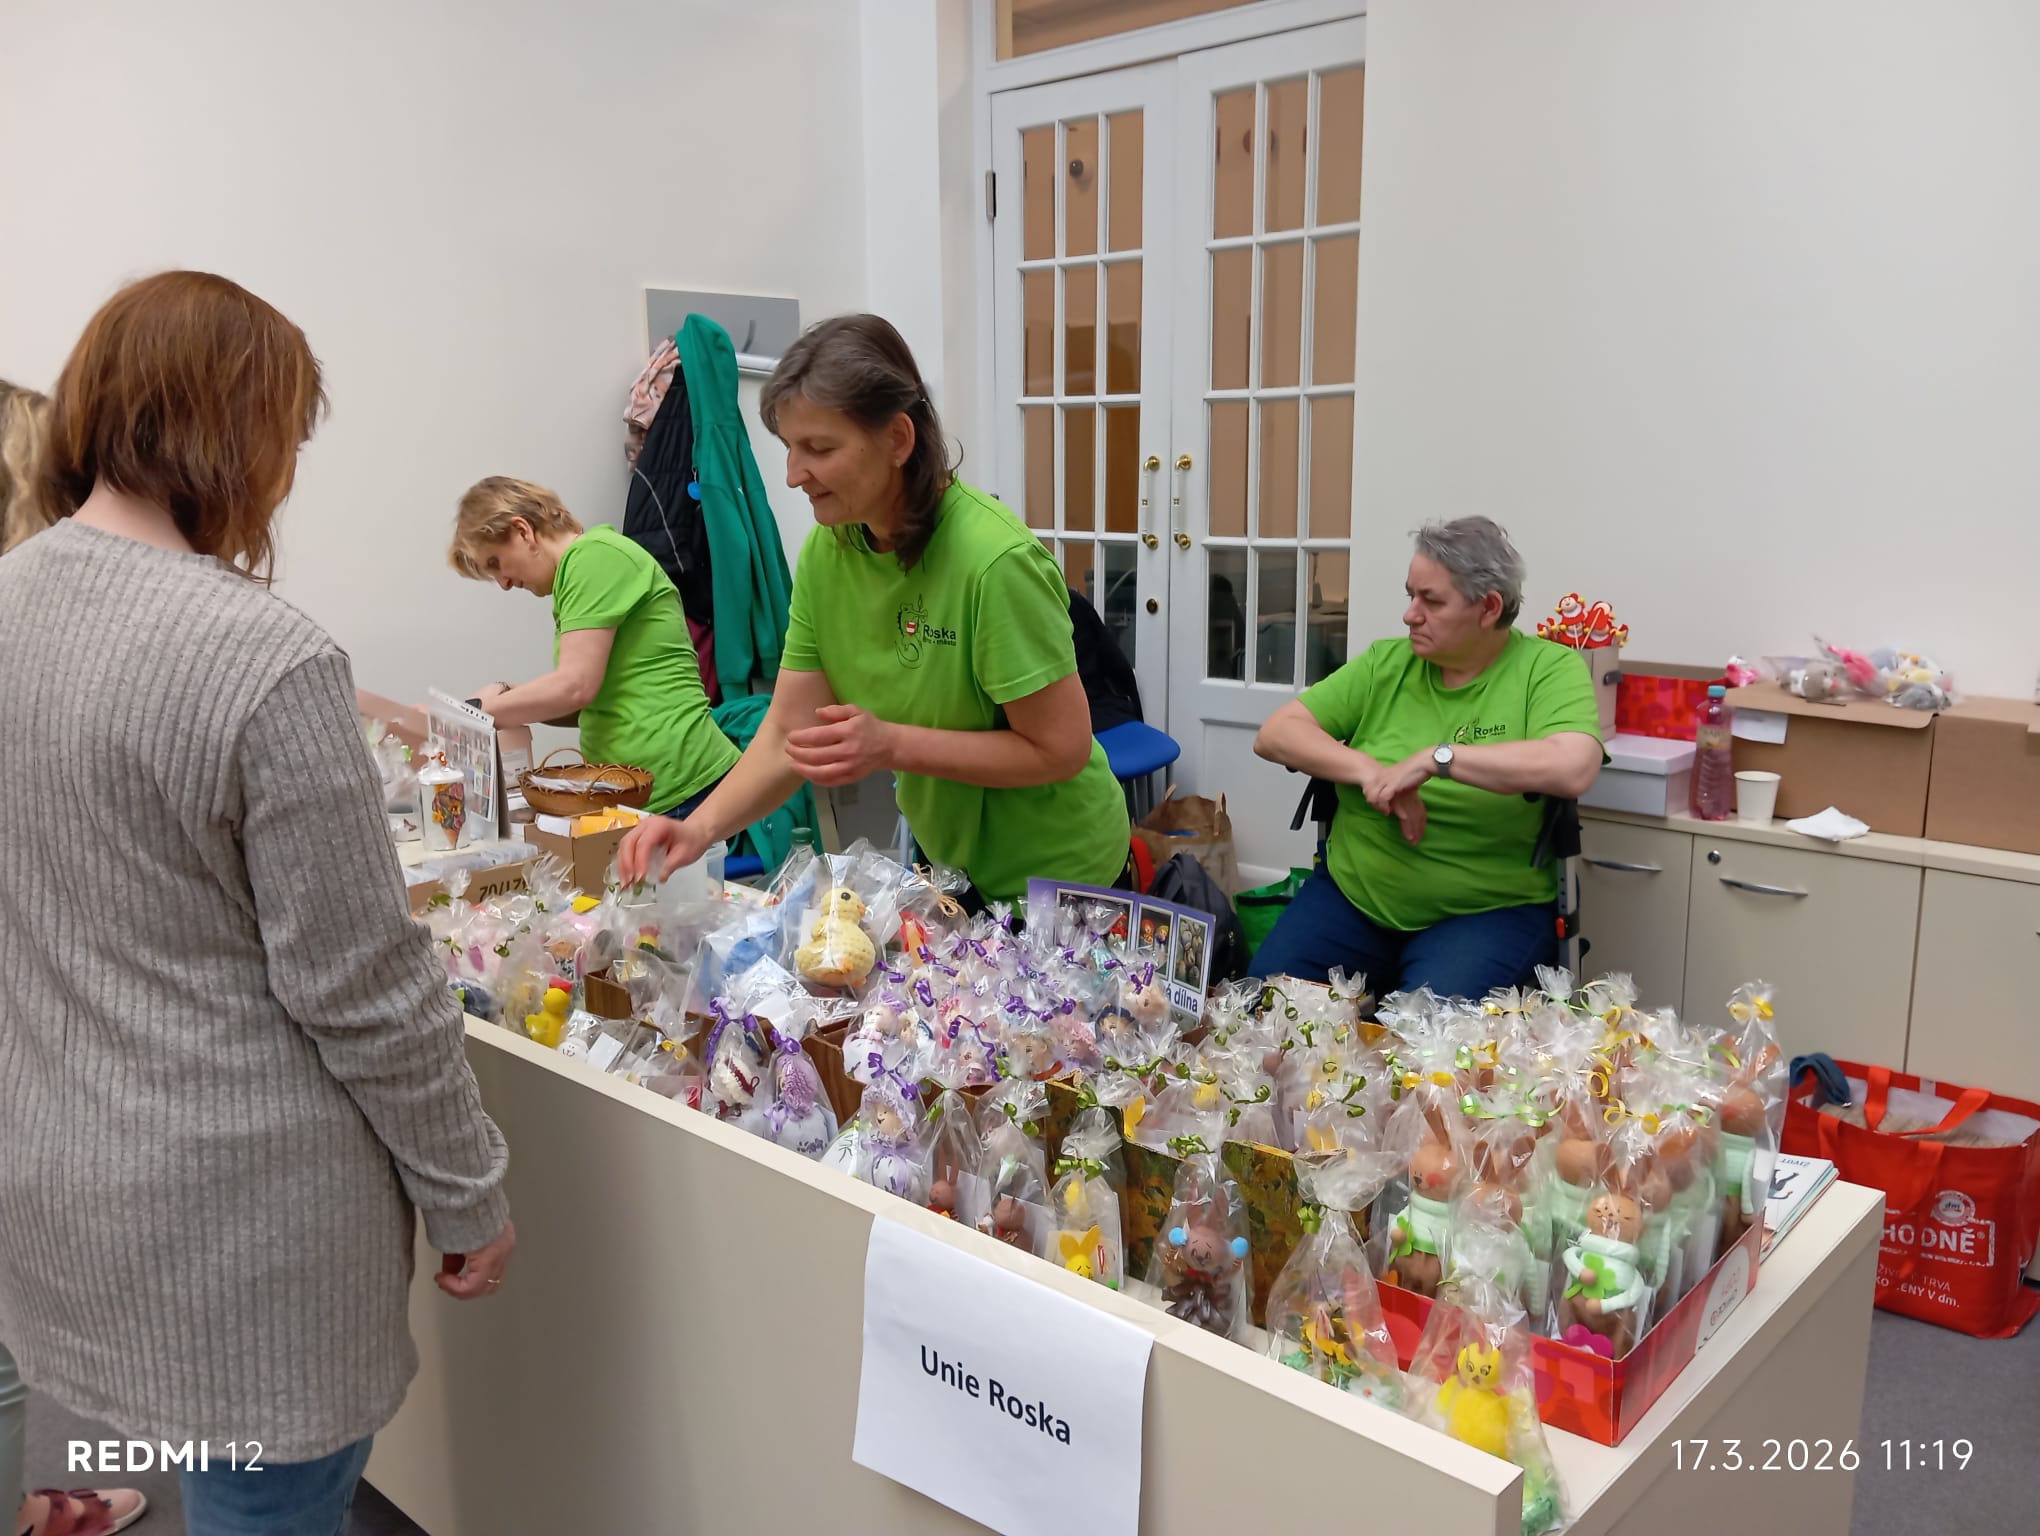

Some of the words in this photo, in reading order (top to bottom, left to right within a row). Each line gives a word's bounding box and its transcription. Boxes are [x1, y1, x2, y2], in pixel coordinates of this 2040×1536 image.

[1473, 723, 1506, 736] Roska
[1174, 986, 1198, 1014] dílna
[1938, 1293, 1960, 1308] dm.
[921, 1344, 980, 1398] Unie
[988, 1378, 1071, 1445] Roska
